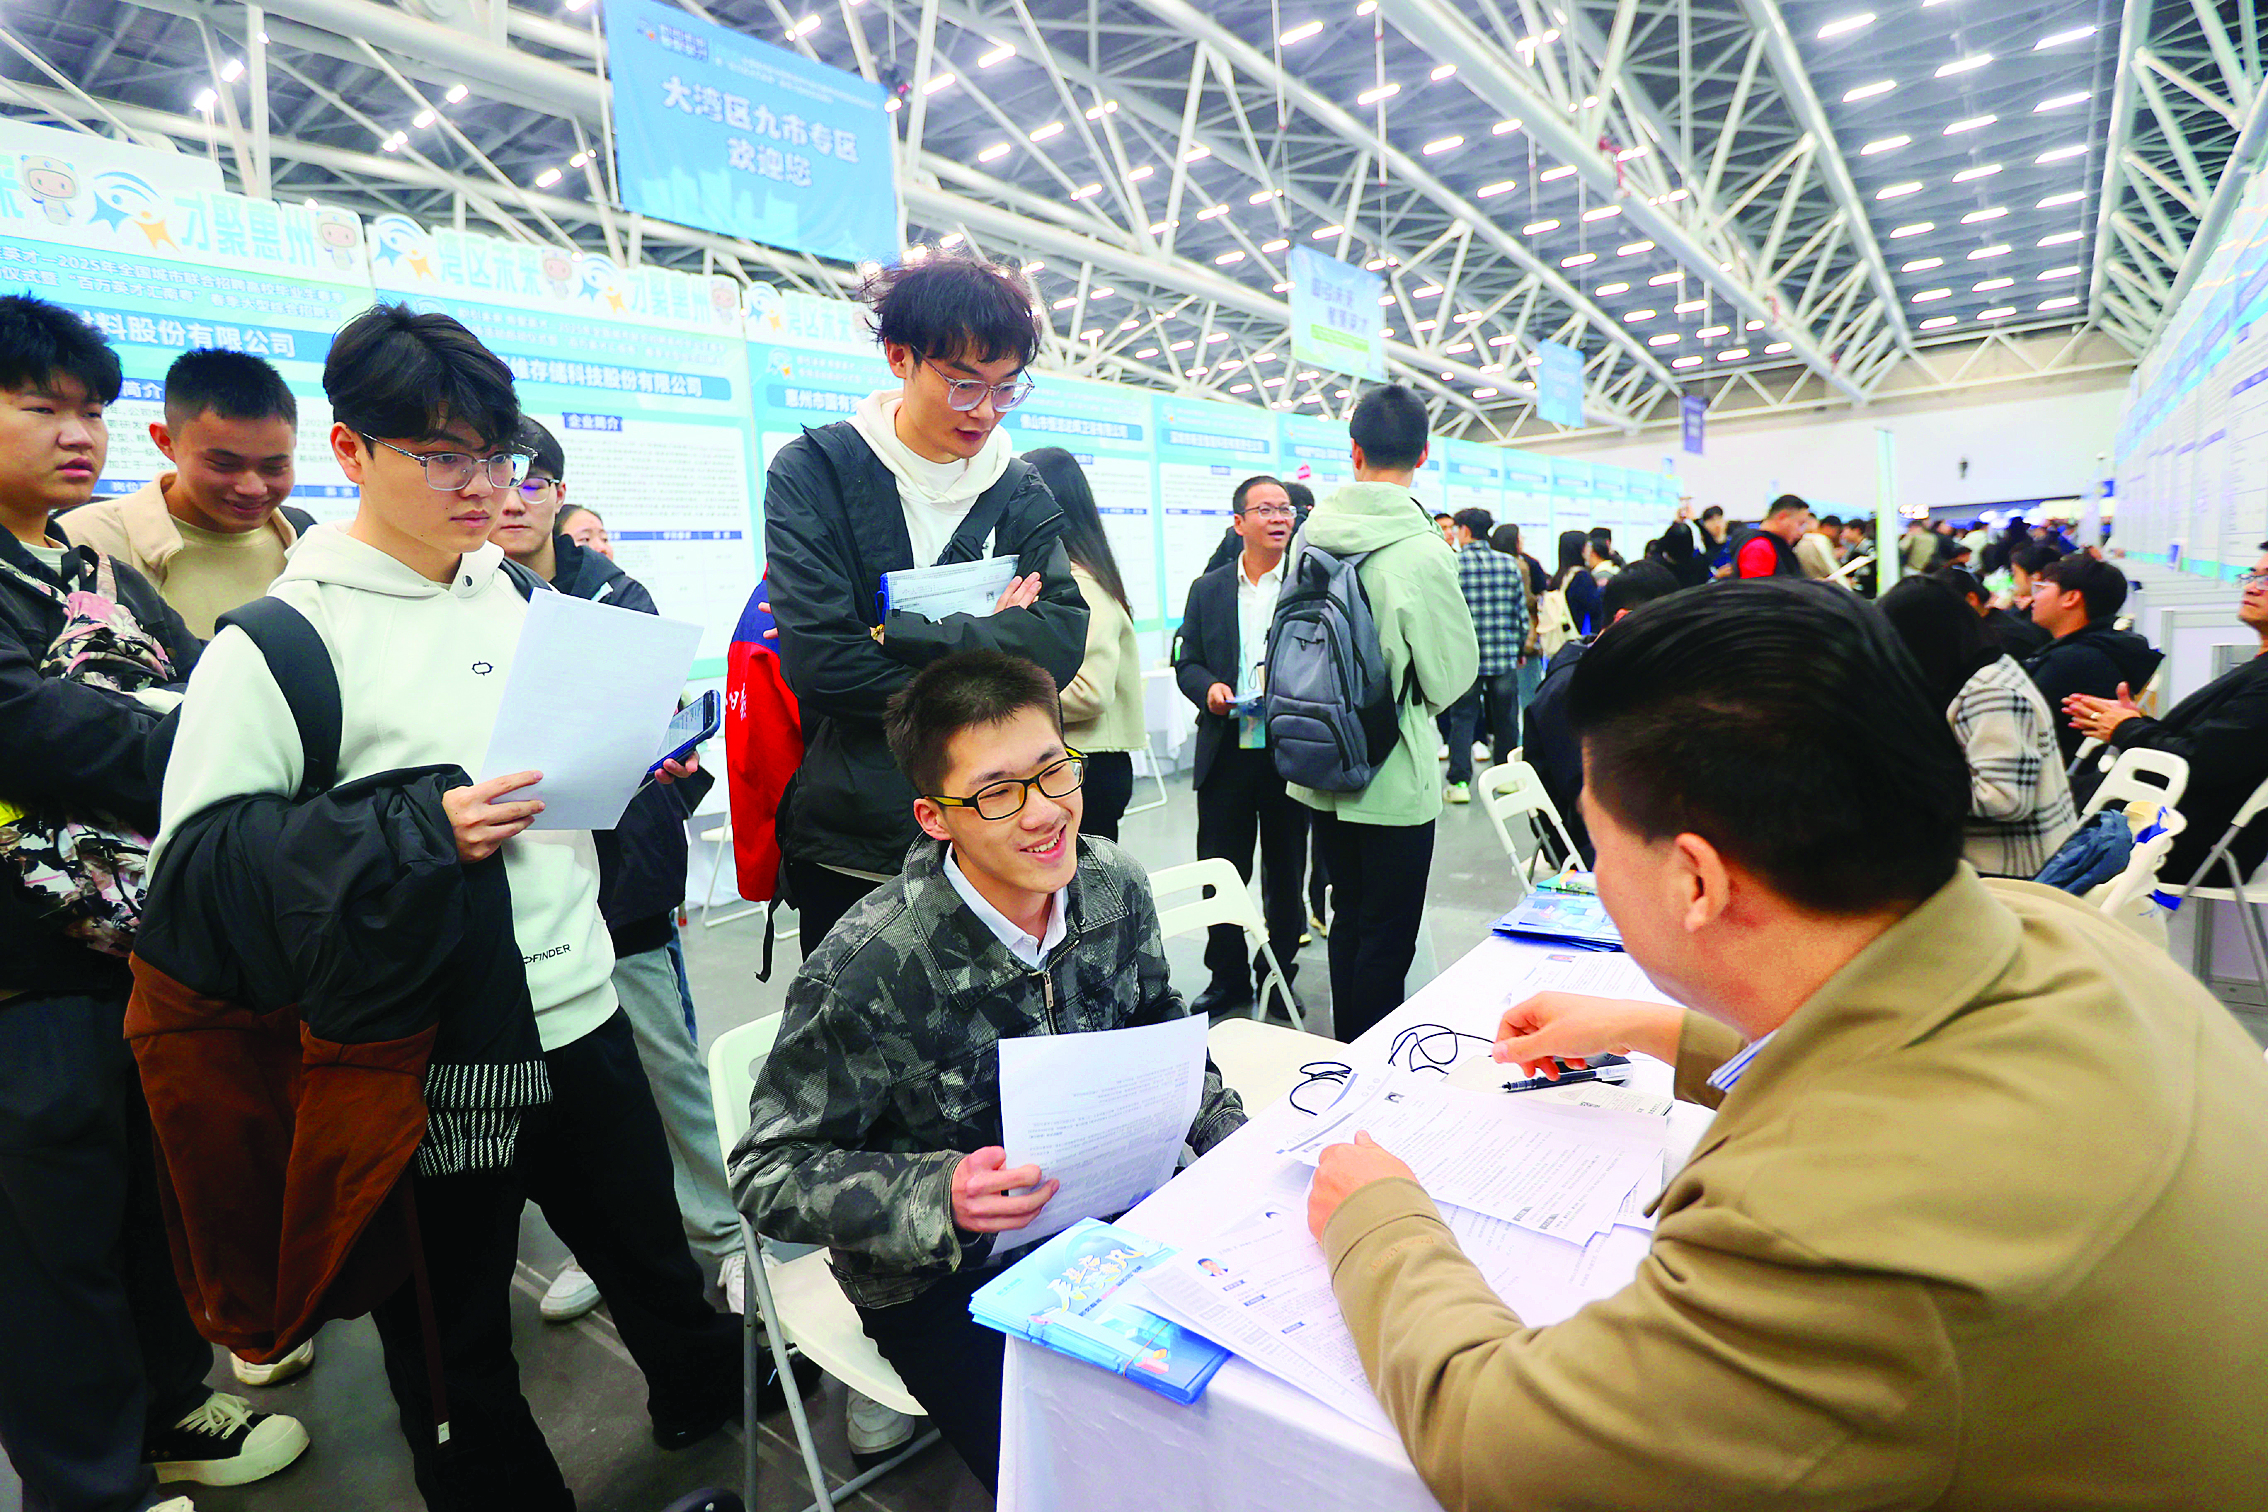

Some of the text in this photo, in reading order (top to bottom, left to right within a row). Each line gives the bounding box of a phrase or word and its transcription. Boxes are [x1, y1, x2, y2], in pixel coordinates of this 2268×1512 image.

[661, 75, 859, 163] 大湾区九市专区
[727, 137, 812, 187] 欢迎您
[0, 266, 60, 286] 仪式暨
[123, 379, 163, 399] 简介
[497, 355, 703, 398] 维存储科技股份有限公司
